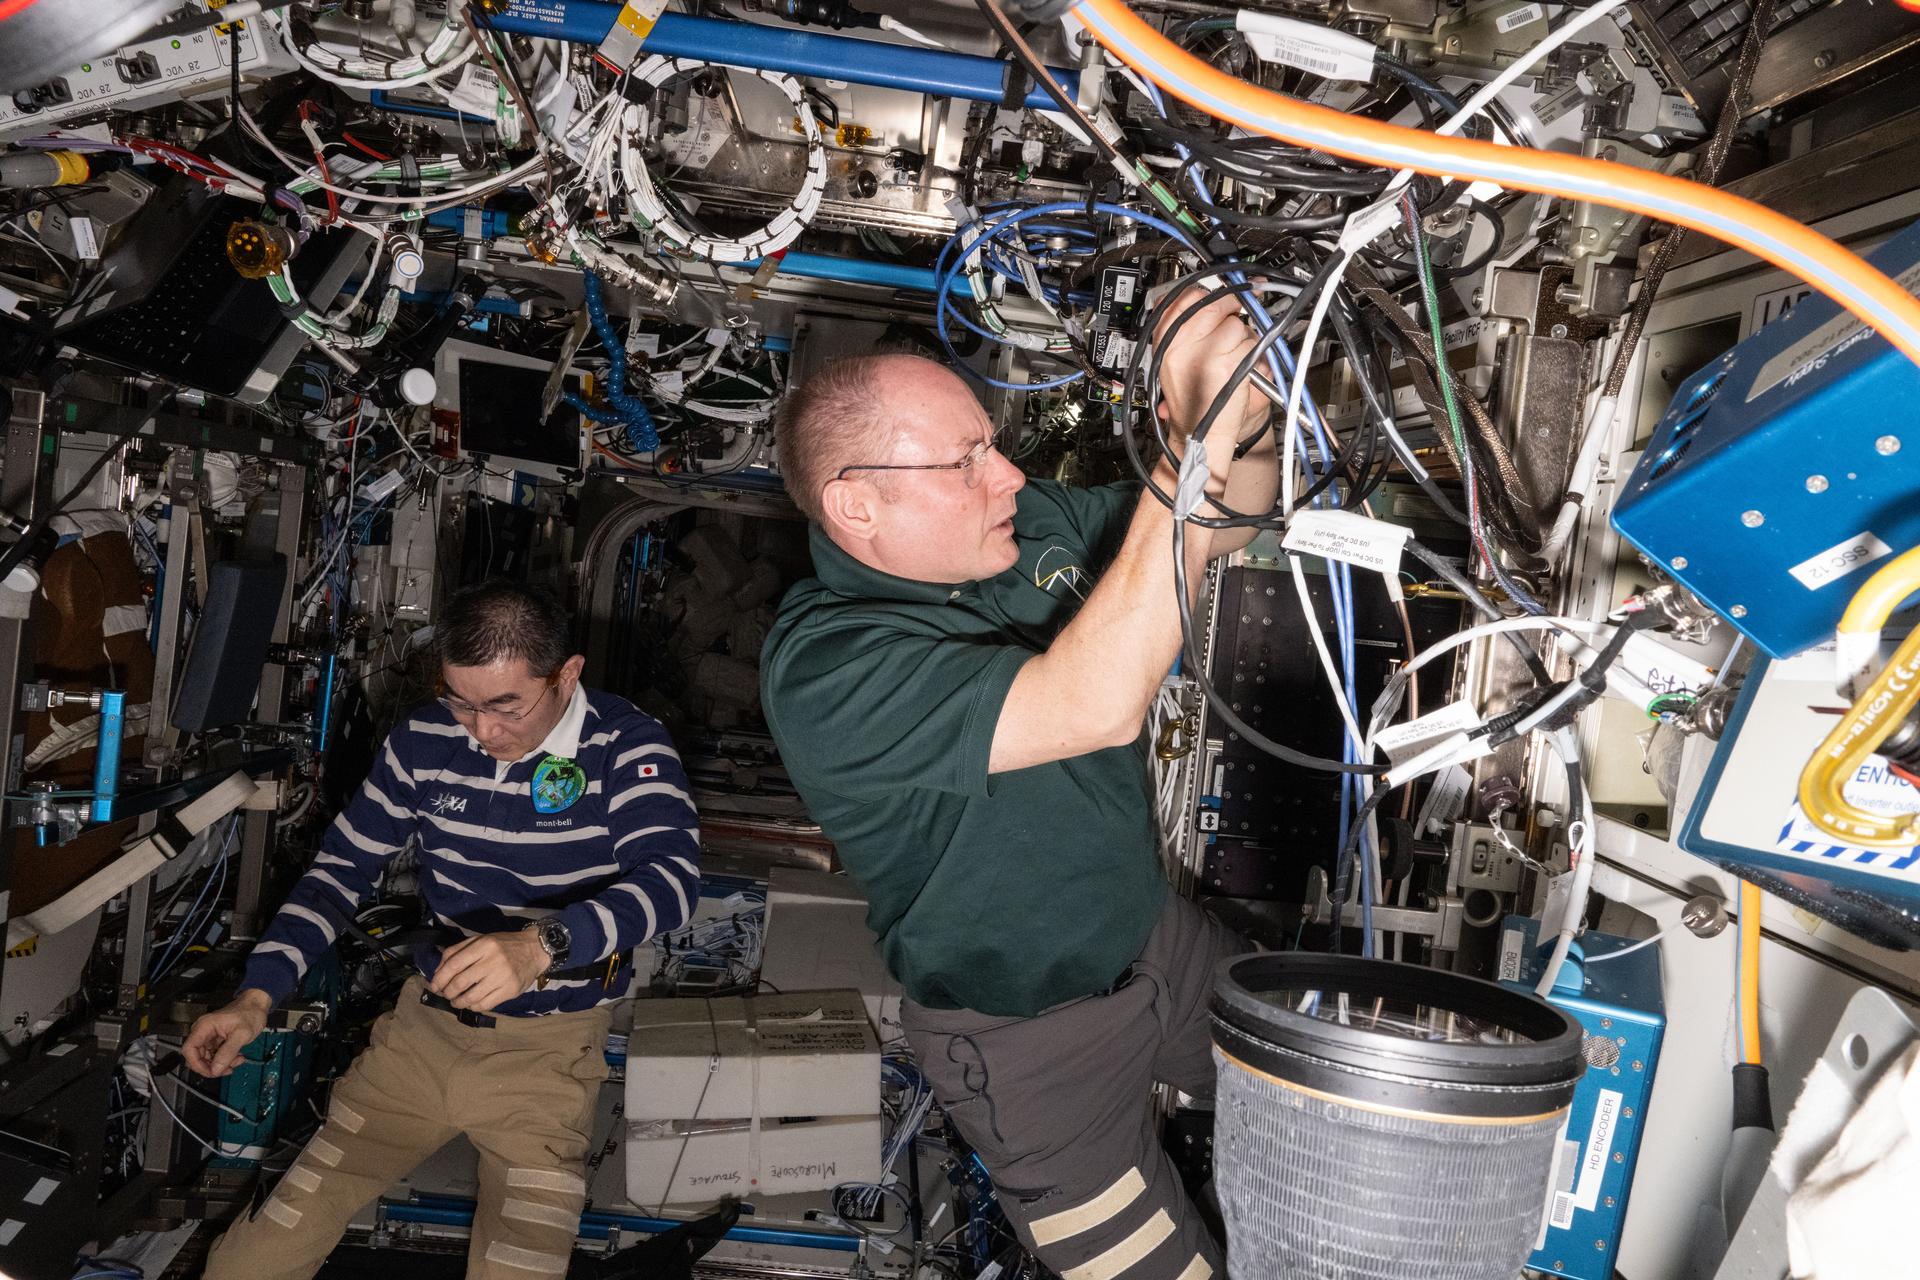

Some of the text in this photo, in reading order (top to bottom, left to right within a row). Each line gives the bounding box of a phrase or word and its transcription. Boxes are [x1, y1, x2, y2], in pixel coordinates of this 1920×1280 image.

[193, 35, 203, 44] ON
[102, 59, 113, 67] ON
[167, 60, 200, 77] 28 VDC
[77, 84, 111, 99] 28 VDC
[1103, 285, 1114, 312] 120 VDC
[1364, 555, 1374, 563] DC
[1808, 545, 1869, 579] SSC 12
[1589, 1098, 1614, 1171] HD ENCODER
